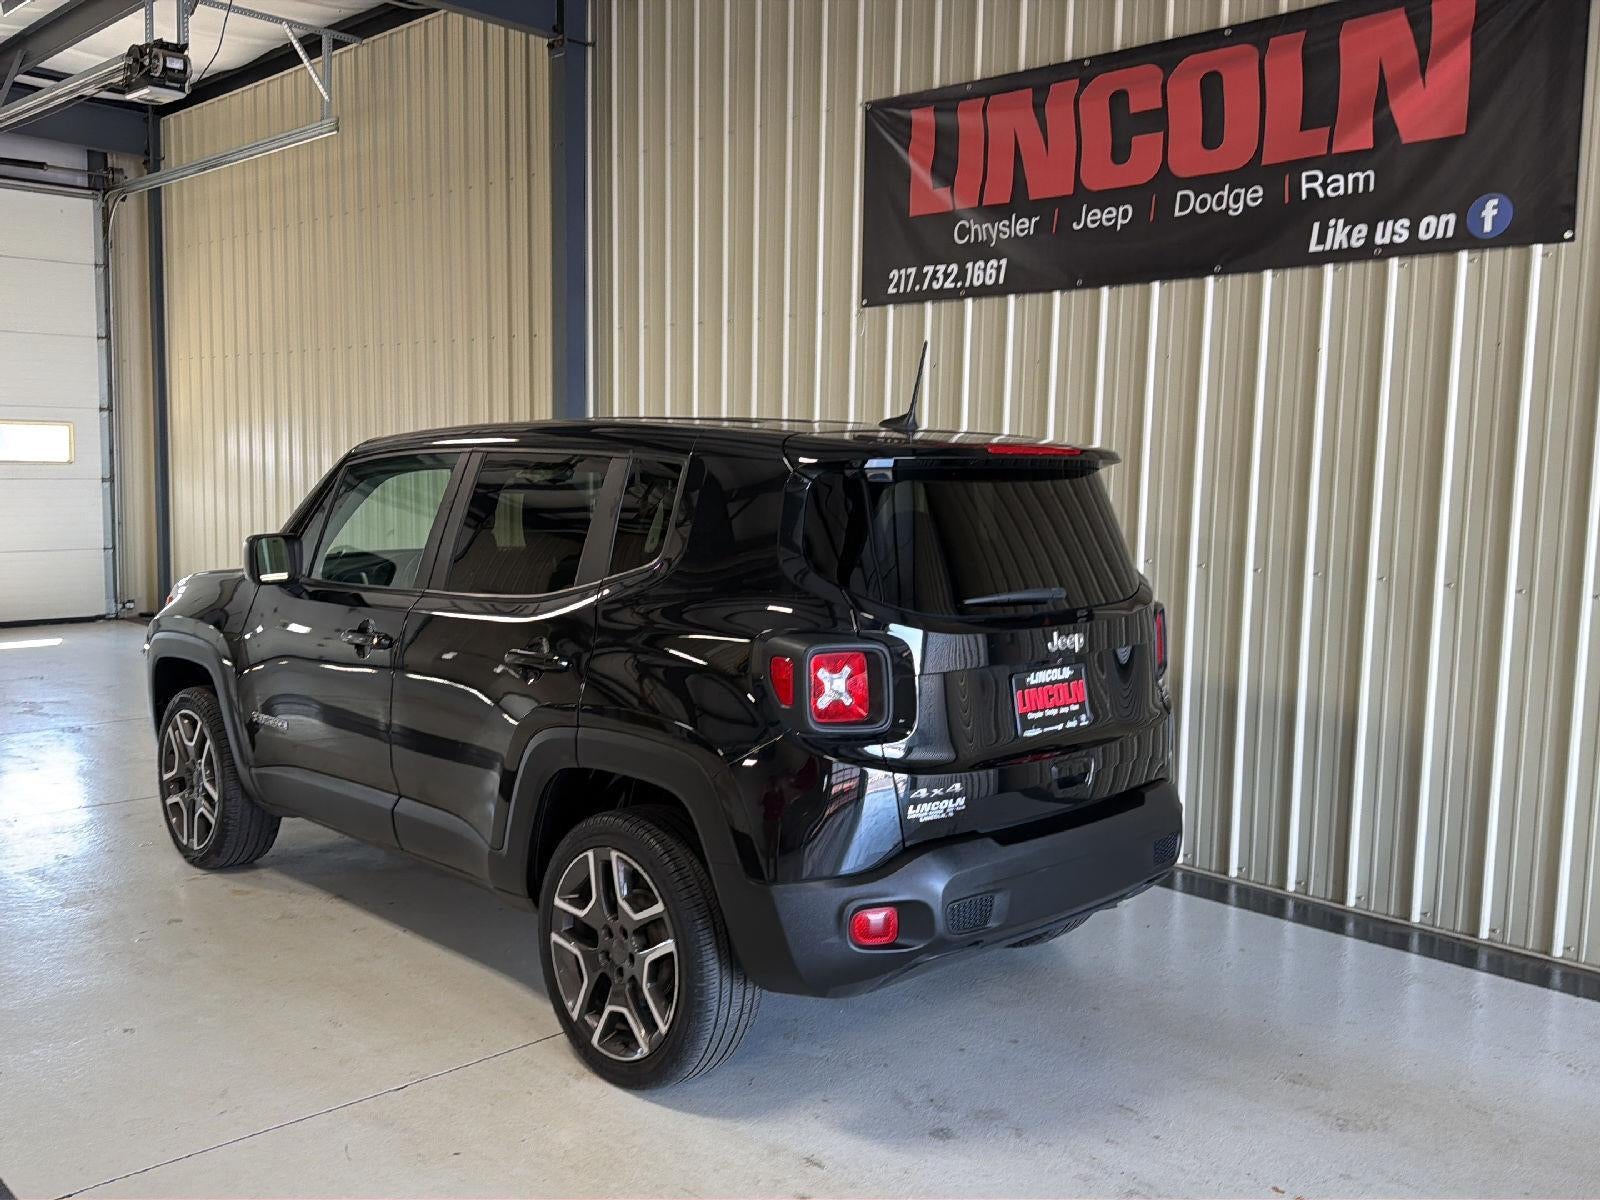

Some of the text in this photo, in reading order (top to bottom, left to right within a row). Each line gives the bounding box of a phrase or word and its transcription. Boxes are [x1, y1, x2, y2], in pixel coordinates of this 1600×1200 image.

[908, 0, 1477, 216] LINCOLN
[953, 168, 1376, 247] Chrysler Jeep Dodge Ram
[1308, 219, 1369, 254] Like
[1374, 217, 1411, 247] us
[1417, 212, 1457, 242] on
[886, 257, 1008, 296] 217.732.1661
[1048, 631, 1084, 653] Jeep
[1029, 666, 1071, 685] LINCOLN
[1016, 679, 1085, 714] LINCOLN
[907, 796, 966, 815] LINCOLN
